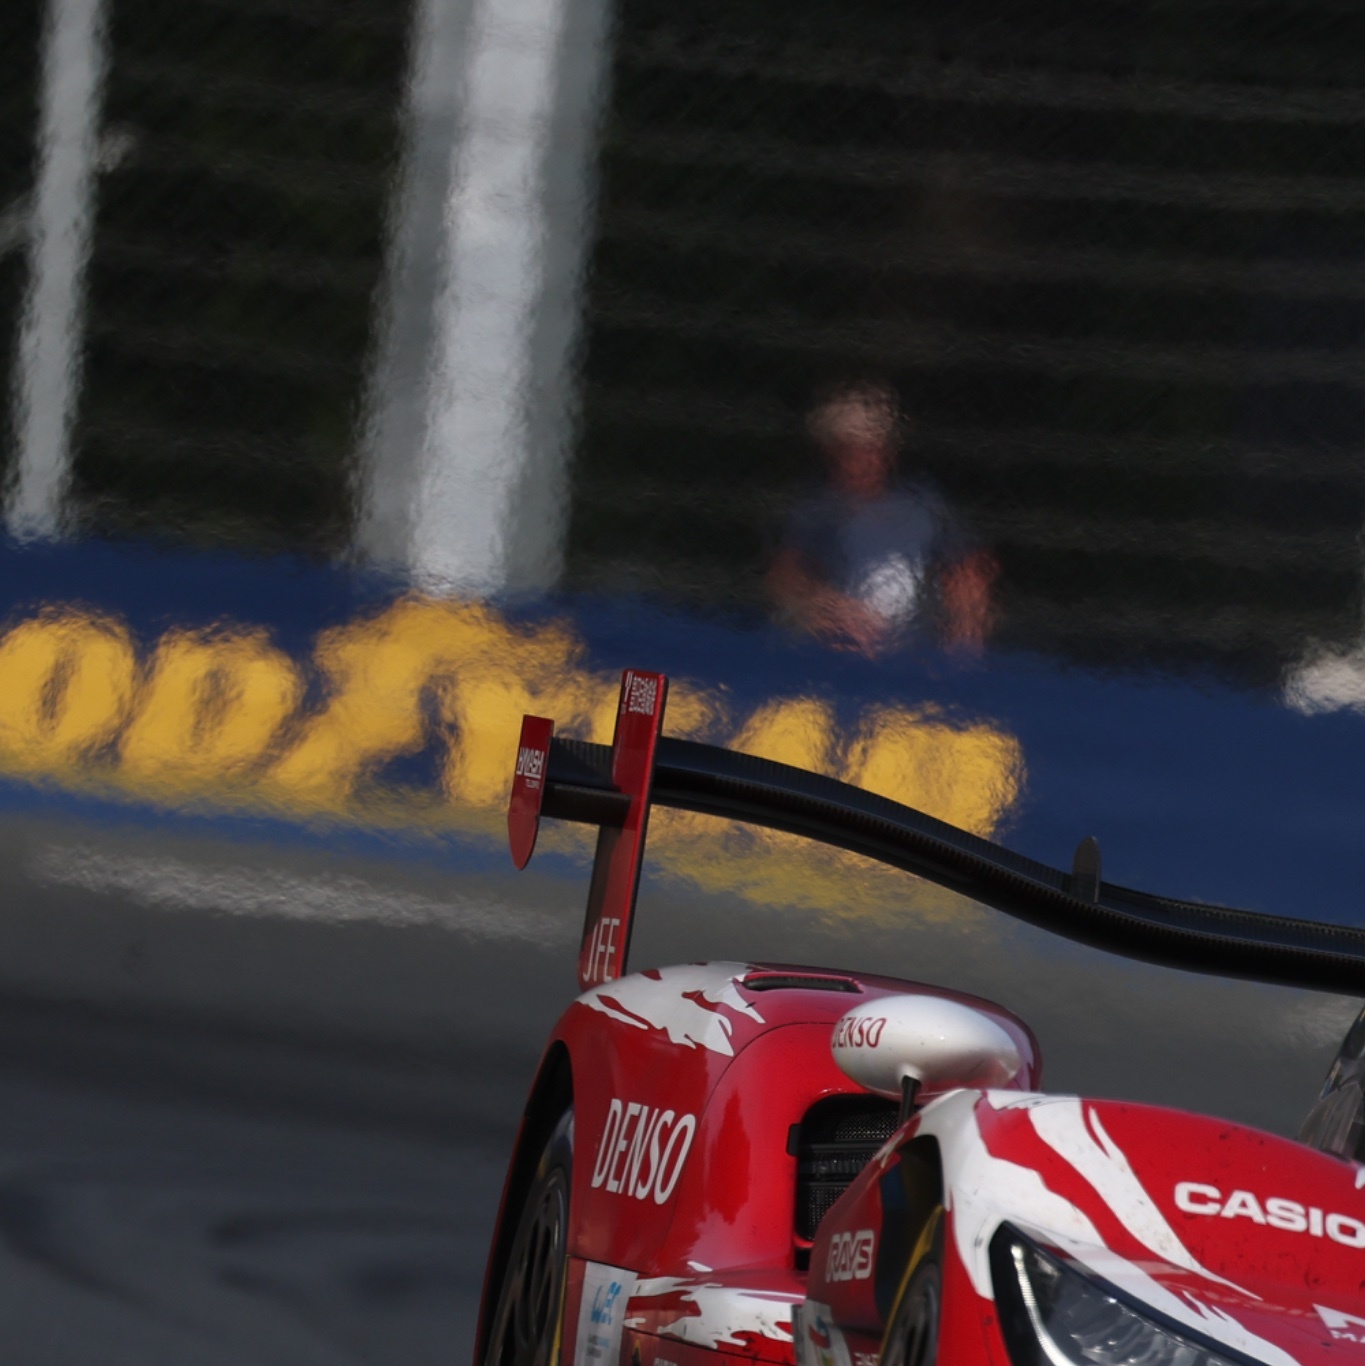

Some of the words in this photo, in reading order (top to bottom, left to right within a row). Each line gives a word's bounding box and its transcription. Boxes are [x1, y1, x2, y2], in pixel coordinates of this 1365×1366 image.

[583, 917, 621, 982] JFE
[831, 1016, 887, 1049] DENSO
[590, 1098, 697, 1206] DENSO
[825, 1229, 875, 1283] RAYS
